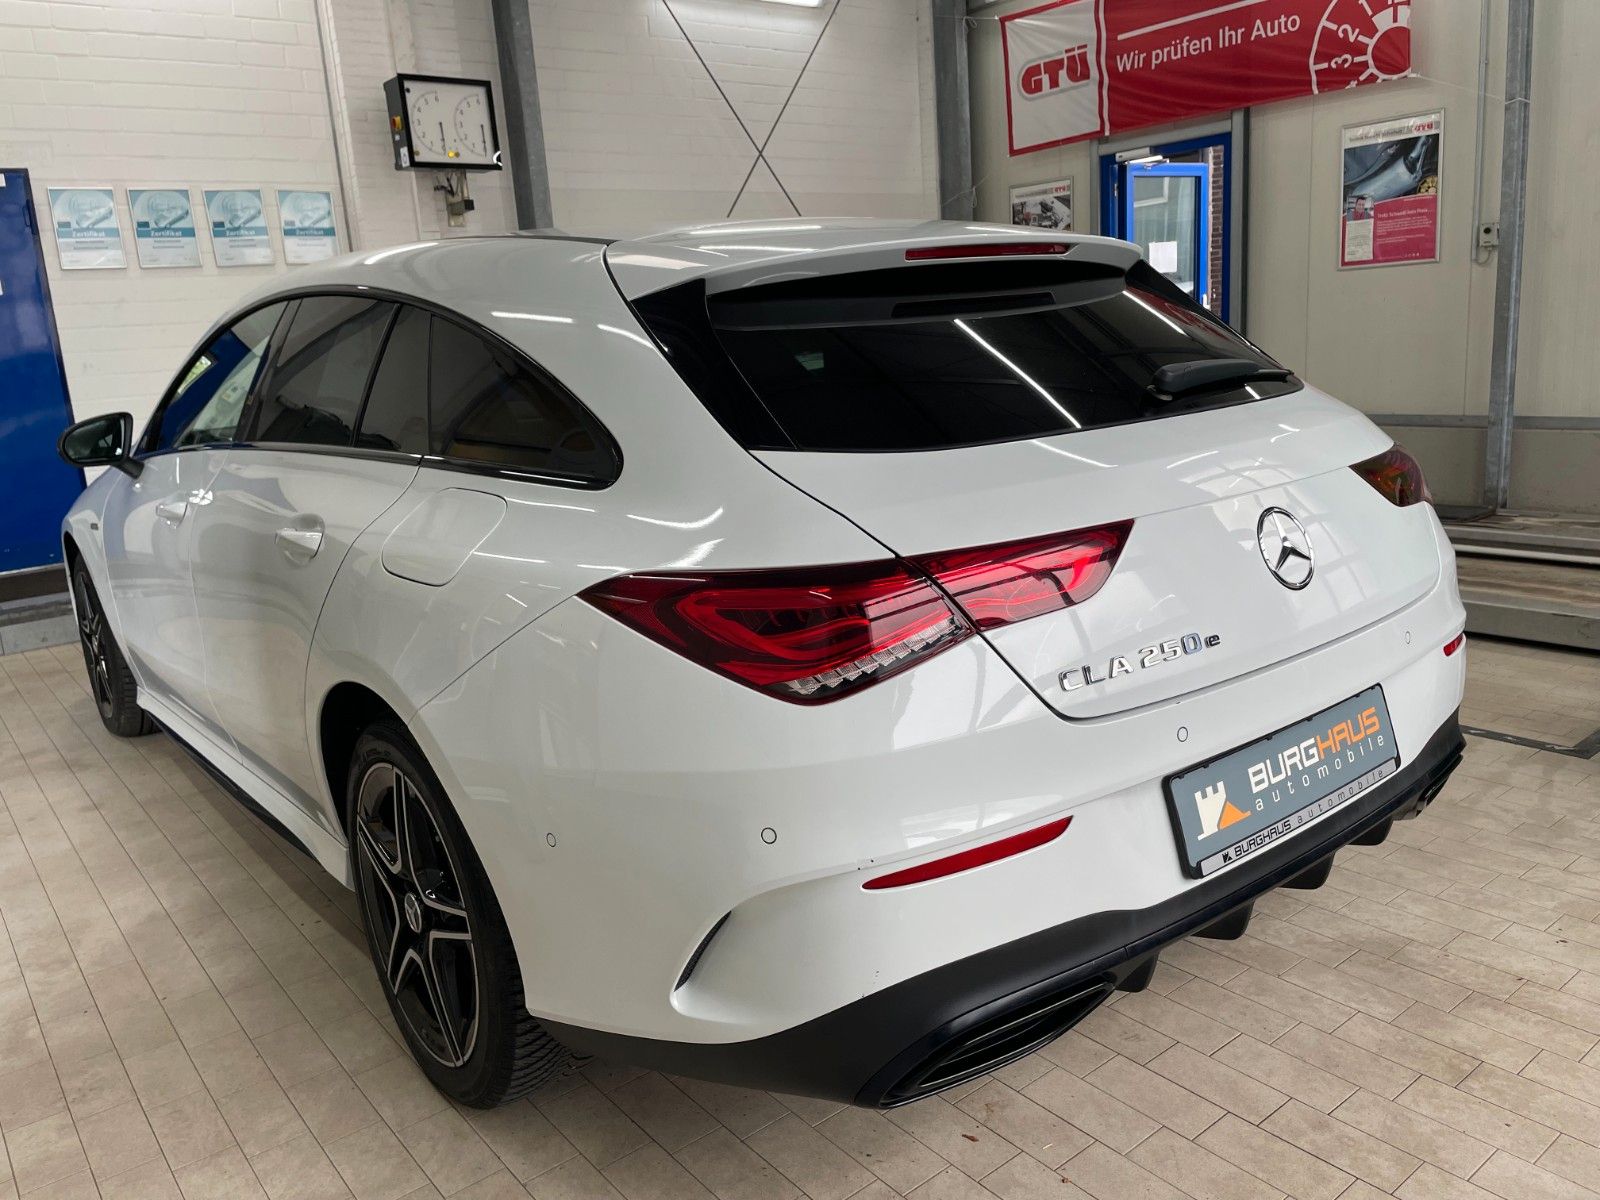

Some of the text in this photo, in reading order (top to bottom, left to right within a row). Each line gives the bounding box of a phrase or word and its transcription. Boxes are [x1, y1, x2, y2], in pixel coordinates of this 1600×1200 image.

[1116, 14, 1301, 73] Wir prüfen Ihr Auto
[1337, 24, 1360, 43] 2
[1021, 44, 1091, 95] GTÜ
[1330, 53, 1353, 70] 3
[72, 230, 105, 238] Zertifikat
[1058, 655, 1135, 692] CLA
[1247, 706, 1381, 794] BURGHAUS
[1254, 734, 1385, 812] automobile
[1234, 768, 1384, 857] BURGHAUS automobile
